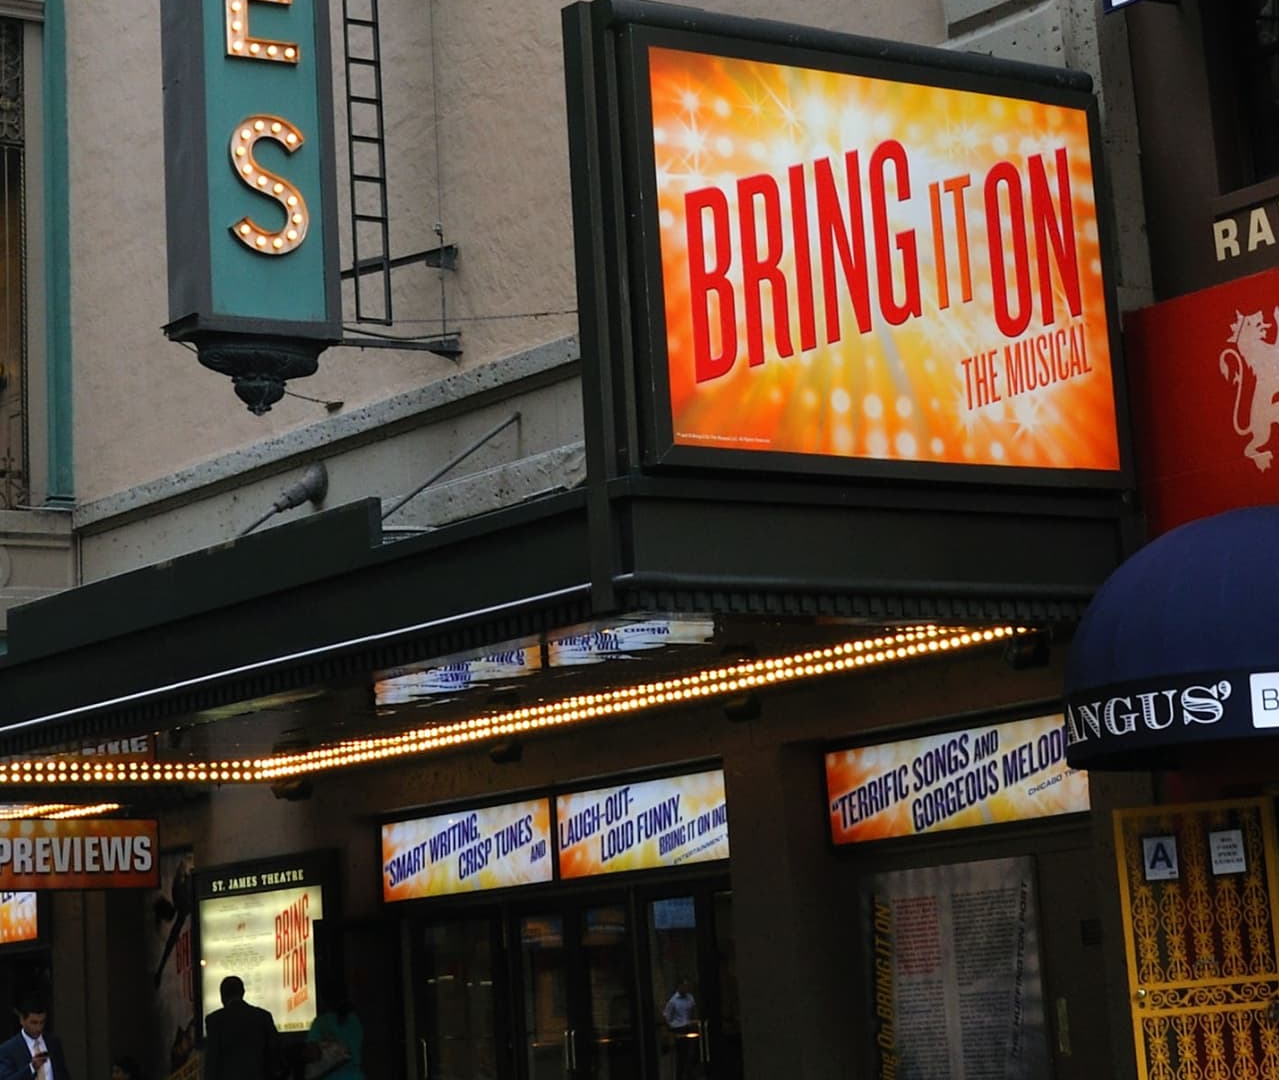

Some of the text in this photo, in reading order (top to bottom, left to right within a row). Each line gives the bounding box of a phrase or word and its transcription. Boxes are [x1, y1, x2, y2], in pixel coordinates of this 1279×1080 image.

[684, 139, 1084, 384] BRING IT ON
[961, 322, 1093, 411] THE MUSICAL
[1066, 680, 1233, 746] ANGUS'
[831, 729, 1000, 830] "TERRIFIC SONGS AND
[911, 724, 1068, 833] GORGEOUS MELODI
[385, 813, 481, 888] "SMART WRITING,
[458, 814, 533, 880] CRISP TUNES
[559, 786, 635, 849] LAUGH-OUT-
[600, 794, 683, 863] LOUD FUNNY.
[659, 825, 686, 857] BRING
[687, 819, 696, 842] IT
[698, 811, 711, 837] ON
[212, 869, 305, 892] ST. JAMES THEATRE
[530, 839, 547, 865] AND
[1150, 841, 1174, 870] A
[275, 893, 310, 961] BRING
[283, 943, 308, 993] IT ON
